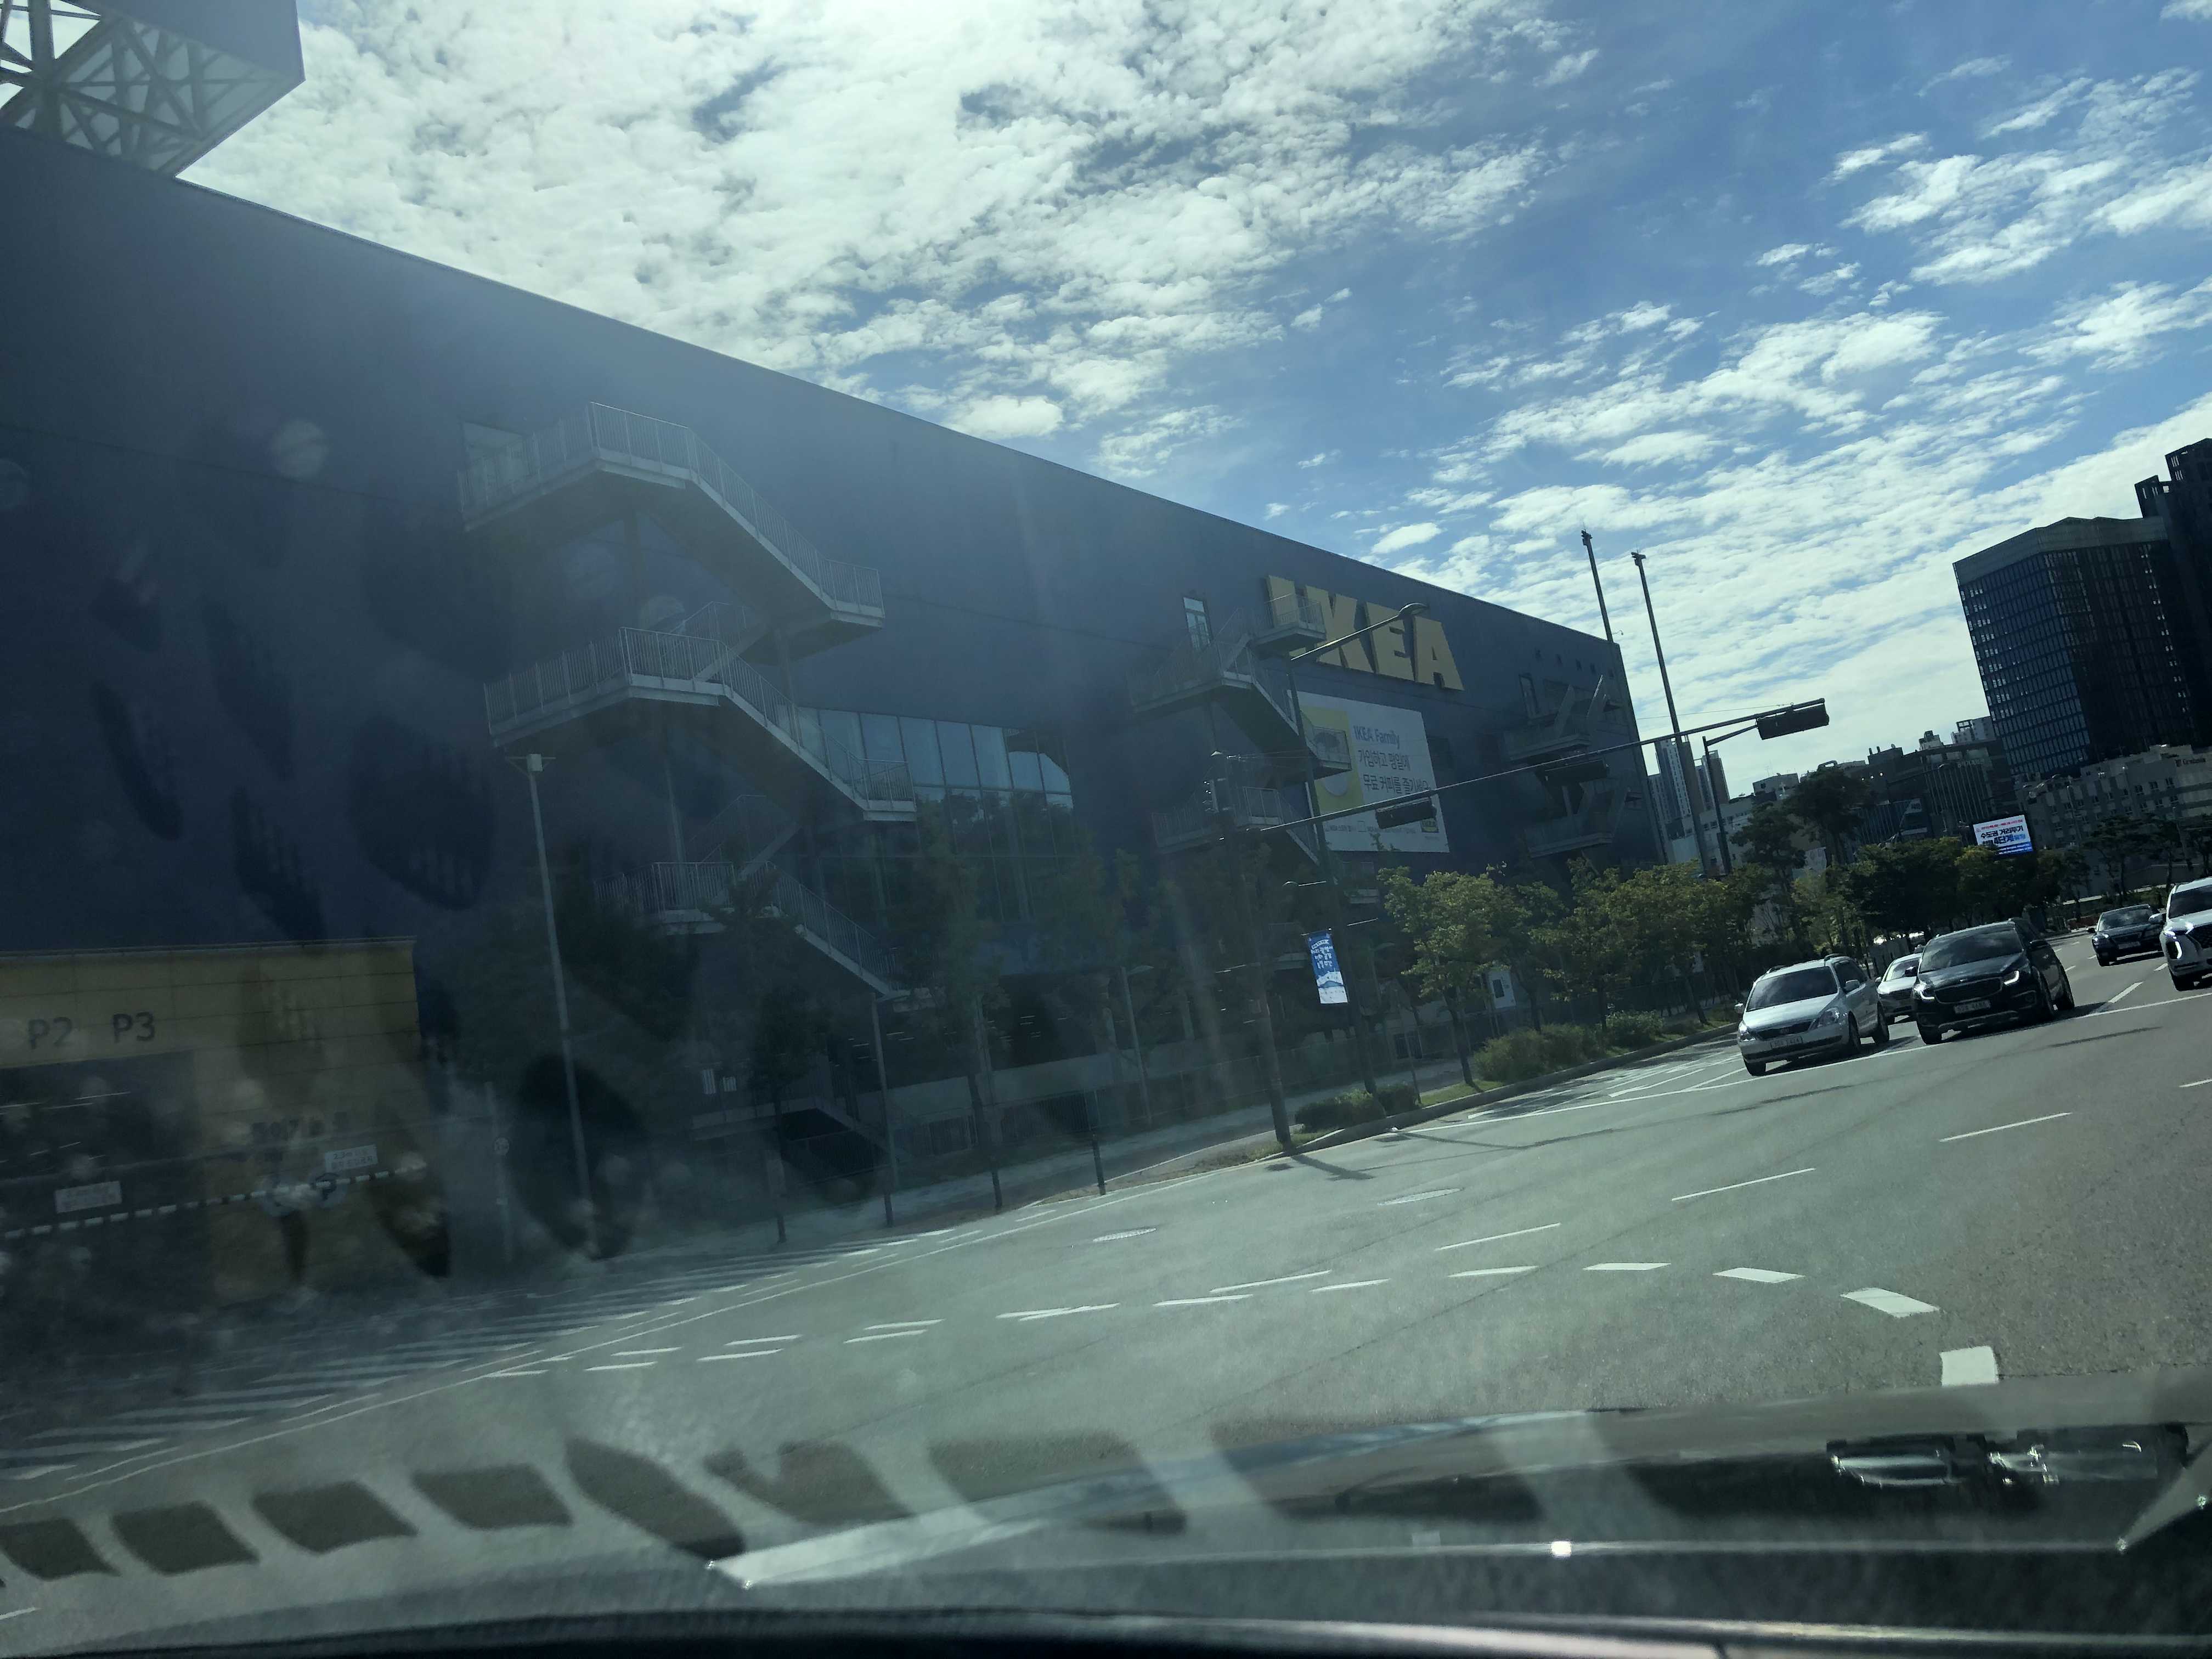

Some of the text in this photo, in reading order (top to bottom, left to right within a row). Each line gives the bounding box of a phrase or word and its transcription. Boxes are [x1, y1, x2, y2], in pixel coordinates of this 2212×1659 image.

[1268, 574, 1465, 691] IKEA
[1353, 725, 1400, 749] IKEA Family
[1358, 749, 1410, 771] 가입하고 평일에
[1363, 774, 1379, 792] 무료
[1380, 775, 1402, 794] 커피를
[1980, 825, 2024, 839] 수도권 거리두기
[27, 1011, 155, 1049] P2 P3
